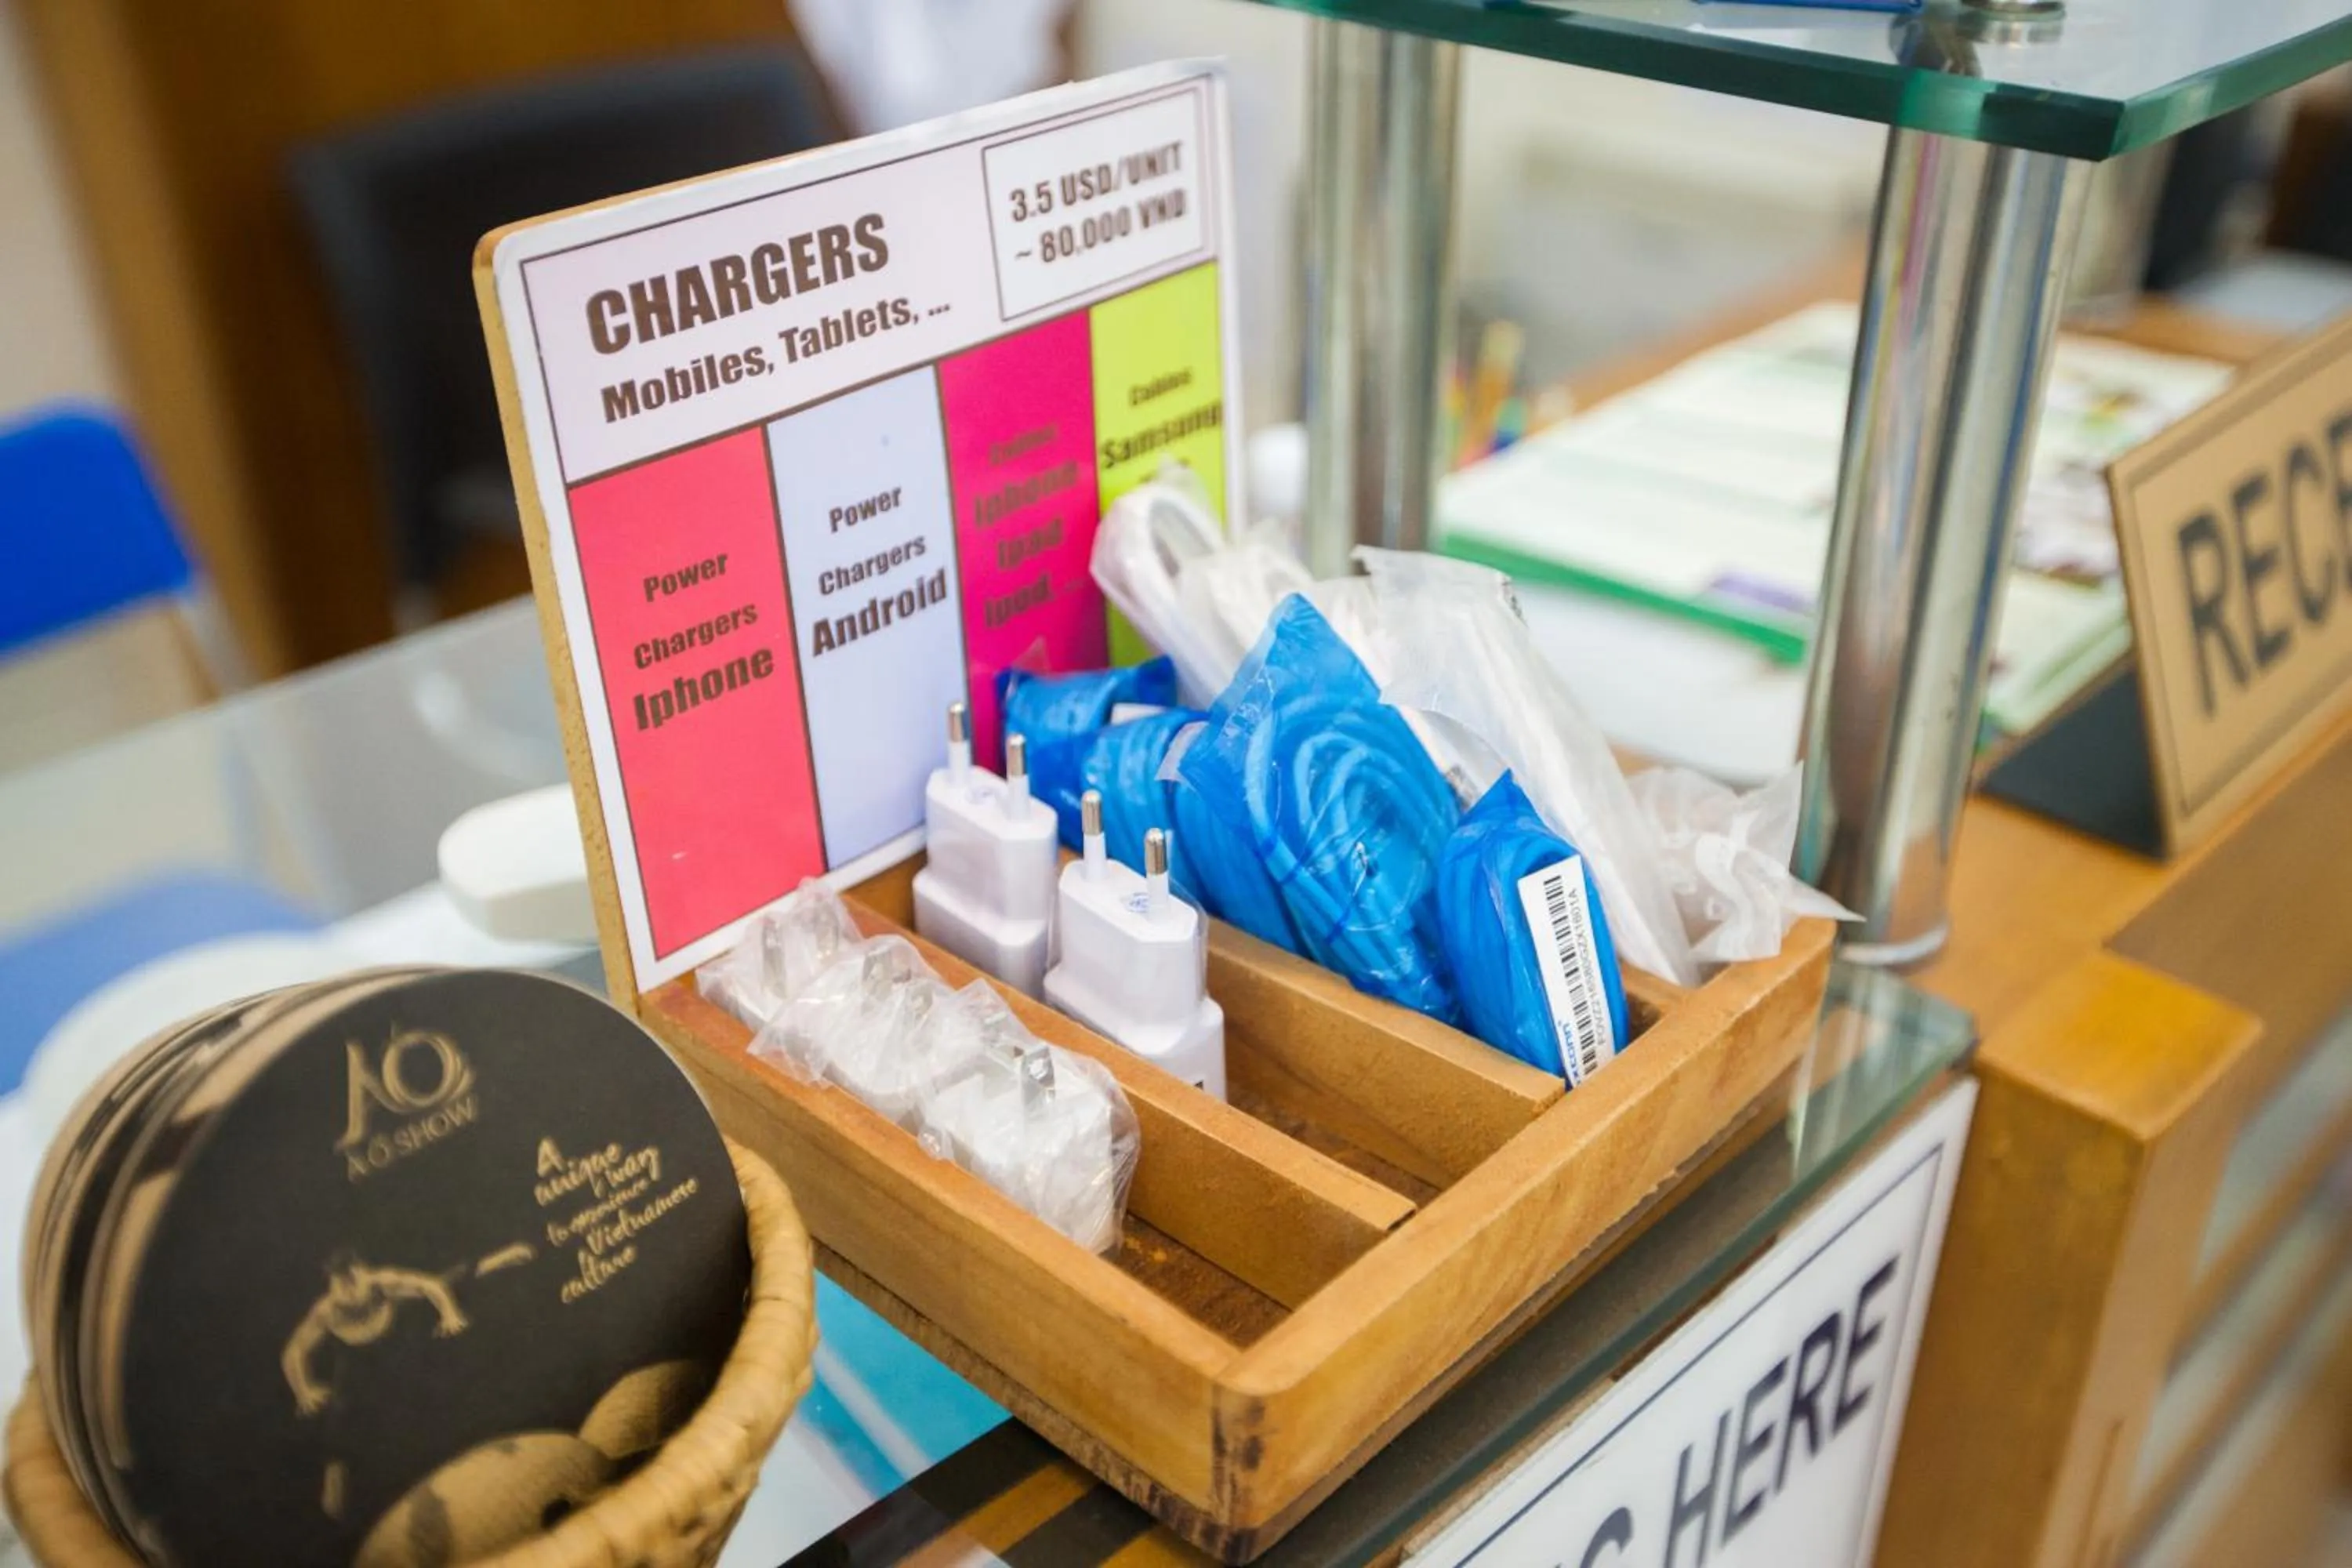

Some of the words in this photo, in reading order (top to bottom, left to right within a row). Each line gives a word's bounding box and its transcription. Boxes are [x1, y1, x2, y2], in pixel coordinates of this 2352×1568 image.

[1010, 181, 1054, 222] 3.5
[1060, 140, 1182, 206] USD/UNIT
[1136, 188, 1188, 229] VND
[586, 212, 889, 355] CHARGERS
[601, 346, 775, 423] Mobiles,
[778, 297, 920, 364] Tablets,
[829, 486, 902, 533] Power
[643, 553, 728, 602] Power
[818, 535, 926, 596] Chargers
[633, 604, 758, 670] Chargers
[811, 567, 947, 657] Android
[633, 648, 775, 731] Iphone
[393, 1096, 477, 1156] SHOW
[536, 1136, 564, 1178] A
[561, 1245, 636, 1304] culture
[1663, 1251, 1901, 1568] HERE
